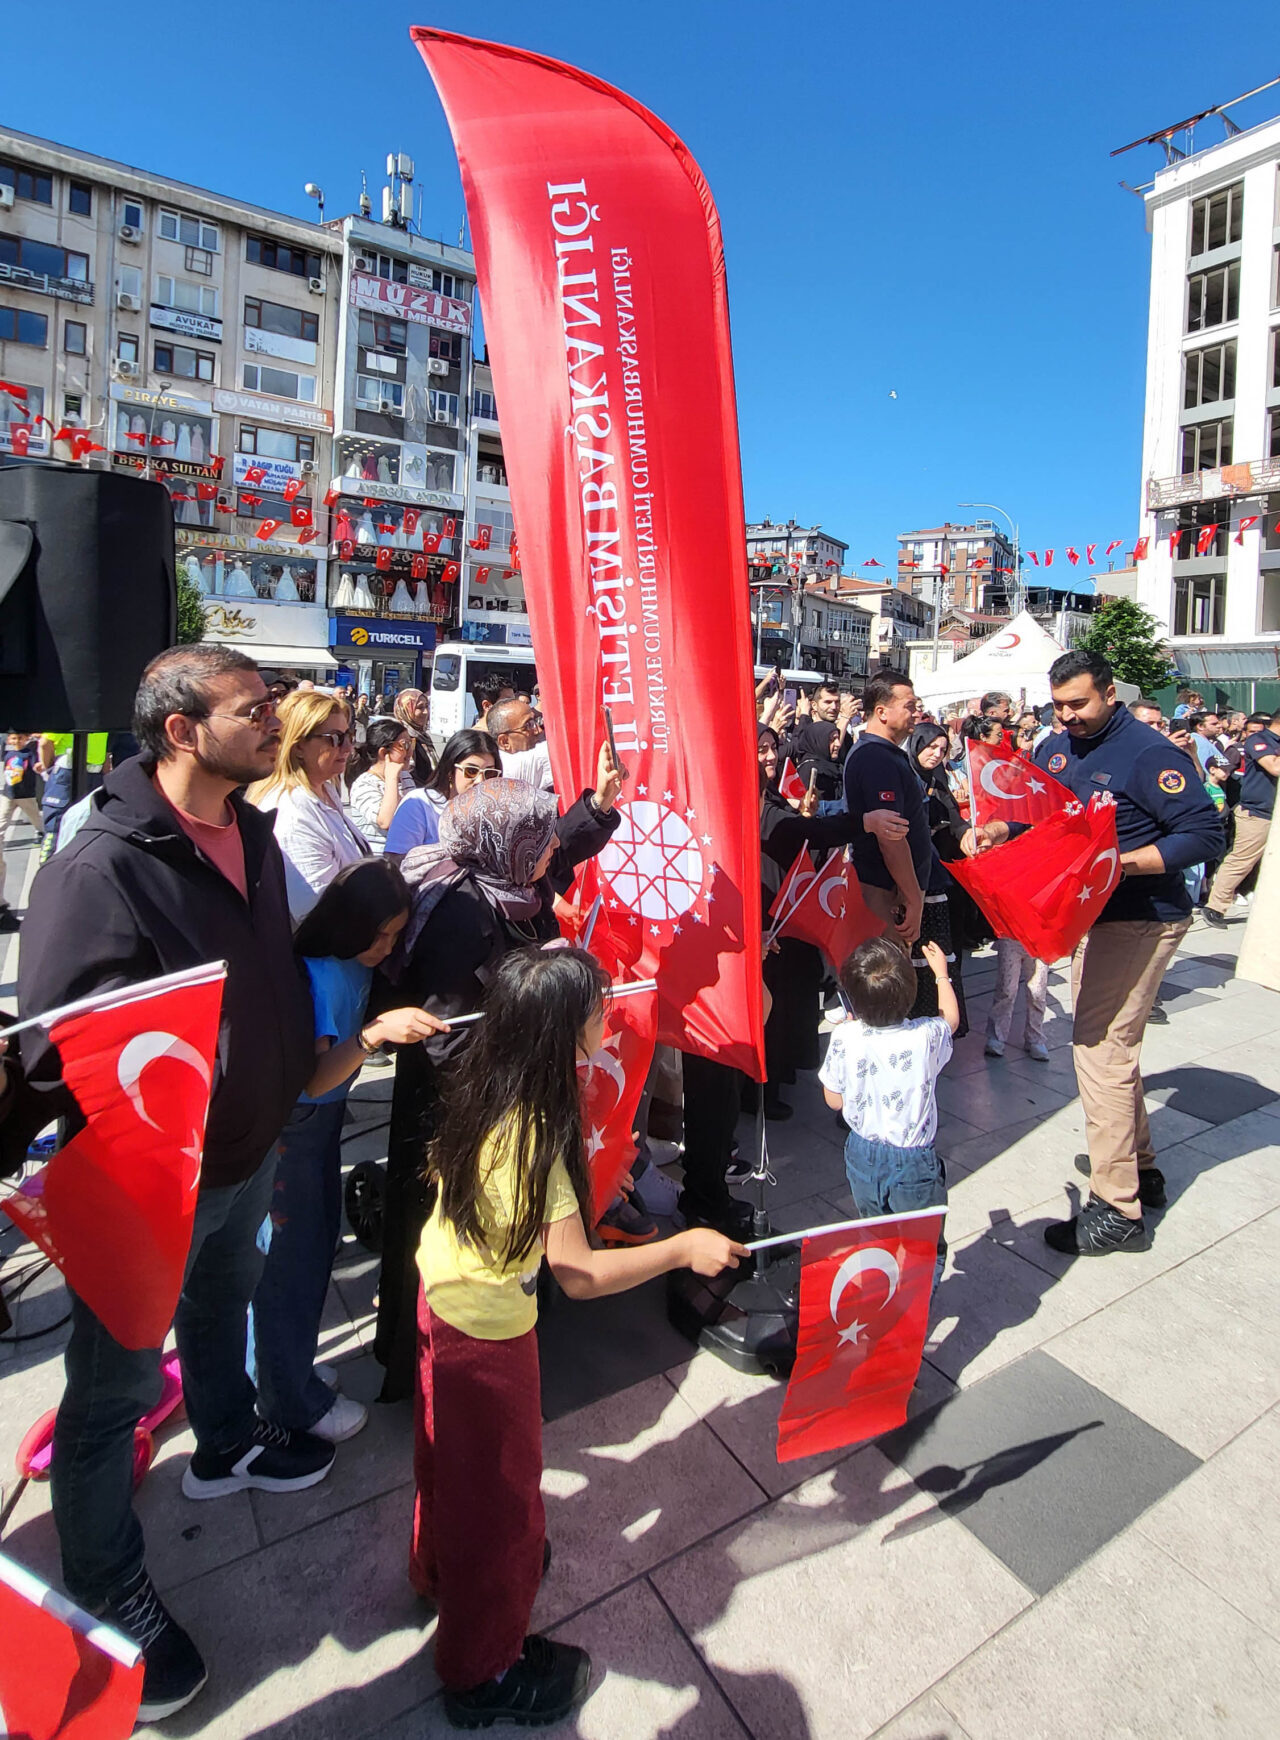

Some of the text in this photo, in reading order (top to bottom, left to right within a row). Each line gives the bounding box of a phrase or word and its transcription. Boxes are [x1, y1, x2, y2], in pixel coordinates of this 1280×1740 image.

[356, 276, 471, 323] MÜZİK
[175, 315, 215, 331] AVUKAT
[240, 398, 280, 414] VATAN
[171, 462, 219, 478] SULTAN
[274, 463, 294, 475] KUĞU
[368, 632, 424, 646] TURKCELL
